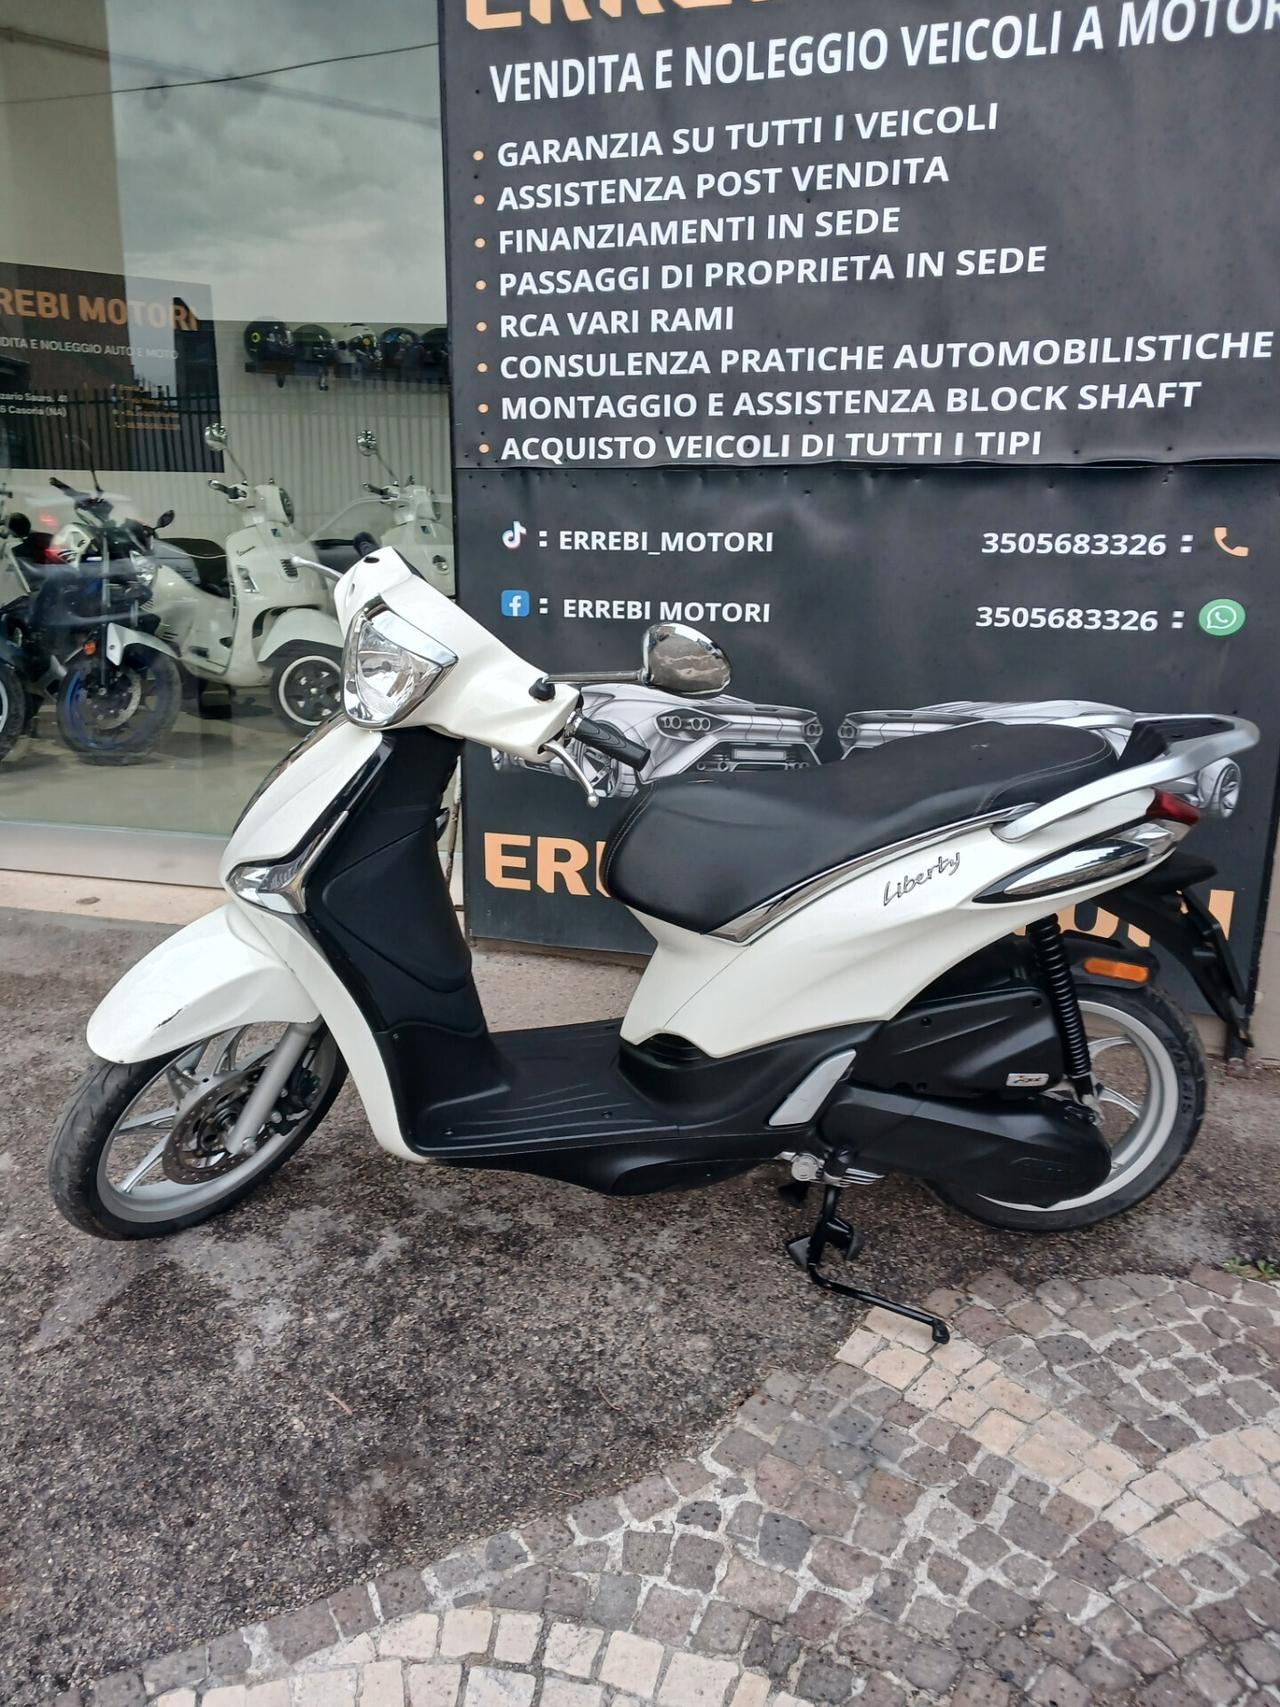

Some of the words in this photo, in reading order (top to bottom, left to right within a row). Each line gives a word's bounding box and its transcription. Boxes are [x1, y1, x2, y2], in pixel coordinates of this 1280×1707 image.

[489, 52, 645, 103] VENDITA
[655, 48, 673, 90] E
[685, 28, 888, 87] NOLEGGIO
[900, 10, 1062, 67] VEICOLI
[1072, 5, 1104, 52] A
[497, 130, 664, 167] GARANZIA
[672, 126, 715, 155] SU
[724, 116, 822, 150] TUTTI
[834, 114, 844, 142] I
[854, 102, 998, 140] VEICOLI
[496, 175, 687, 212] ASSISTENZA
[696, 167, 783, 199] POST
[791, 155, 950, 192] VENDITA
[499, 214, 755, 255] FINANZIAMENTI
[767, 213, 804, 240] IN
[814, 206, 901, 237] SEDE
[500, 266, 650, 297] PASSAGGI
[661, 263, 693, 289] DI
[705, 254, 895, 287] PROPRIETA
[906, 251, 945, 279] IN
[955, 245, 1047, 276] SEDE
[500, 313, 560, 338] RCA
[566, 309, 639, 336] VARI
[650, 306, 734, 333] RAMI
[30, 339, 39, 350] E
[40, 340, 102, 354] NOLEGGIO
[103, 344, 134, 356] AUTO
[500, 350, 711, 379] CONSULENZA
[721, 345, 885, 374] PRATICHE
[892, 331, 1274, 369] AUTOMOBILISTICHE
[501, 394, 697, 420] MONTAGGIO
[708, 392, 724, 417] E
[732, 388, 936, 416] ASSISTENZA
[946, 385, 1069, 413] BLOCK
[1077, 381, 1202, 410] SHAFT
[500, 436, 657, 465] ACQUISTO
[664, 434, 790, 459] VEICOLI
[801, 433, 835, 458] DI
[844, 432, 942, 457] TUTTI
[954, 432, 964, 456] I
[974, 431, 1042, 456] TIPI
[559, 530, 773, 555] ERREBI_MOTORI
[981, 532, 1167, 556] 3505683326
[563, 599, 651, 620] ERREBI
[659, 601, 770, 623] MOTORI
[975, 606, 1158, 632] 3505683326
[883, 851, 960, 907] Liberty
